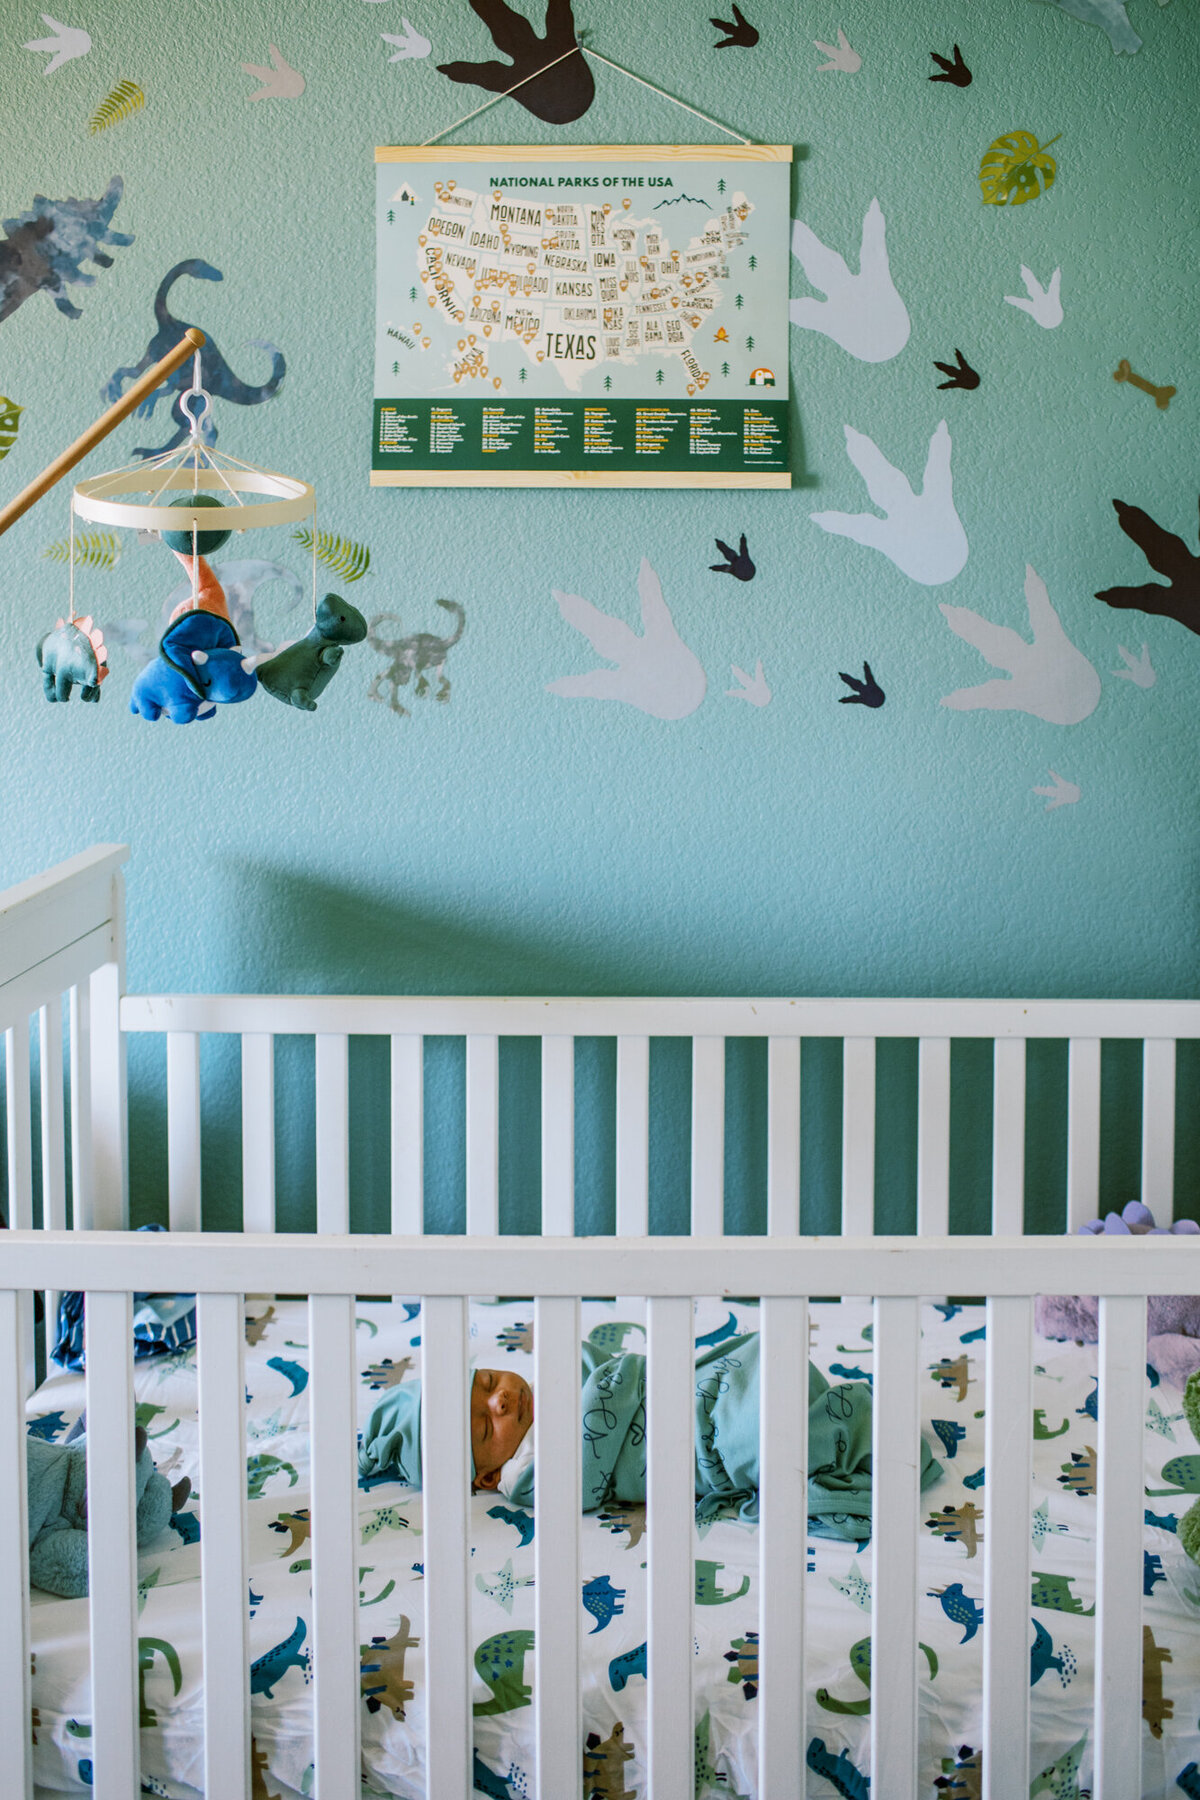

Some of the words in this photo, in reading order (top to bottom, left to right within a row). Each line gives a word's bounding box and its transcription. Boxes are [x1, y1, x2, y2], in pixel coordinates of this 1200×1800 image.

[489, 177, 555, 188] NATIONAL
[557, 177, 600, 188] PARKS
[602, 177, 620, 188] OF
[621, 177, 645, 188] THE
[647, 177, 674, 188] USA
[490, 204, 542, 228] MONTANA
[427, 216, 466, 240] OREGON
[469, 231, 501, 250] IDAHO
[445, 252, 477, 271] NEVADA
[543, 254, 588, 273] NEBRASKA
[593, 252, 617, 269] IOWA
[661, 261, 680, 274] OHIO
[513, 273, 550, 294] OLORADO
[555, 281, 593, 298] KANSAS
[504, 315, 540, 333] MEXICO
[386, 327, 416, 350] HAWAII
[546, 332, 597, 361] TEXAS
